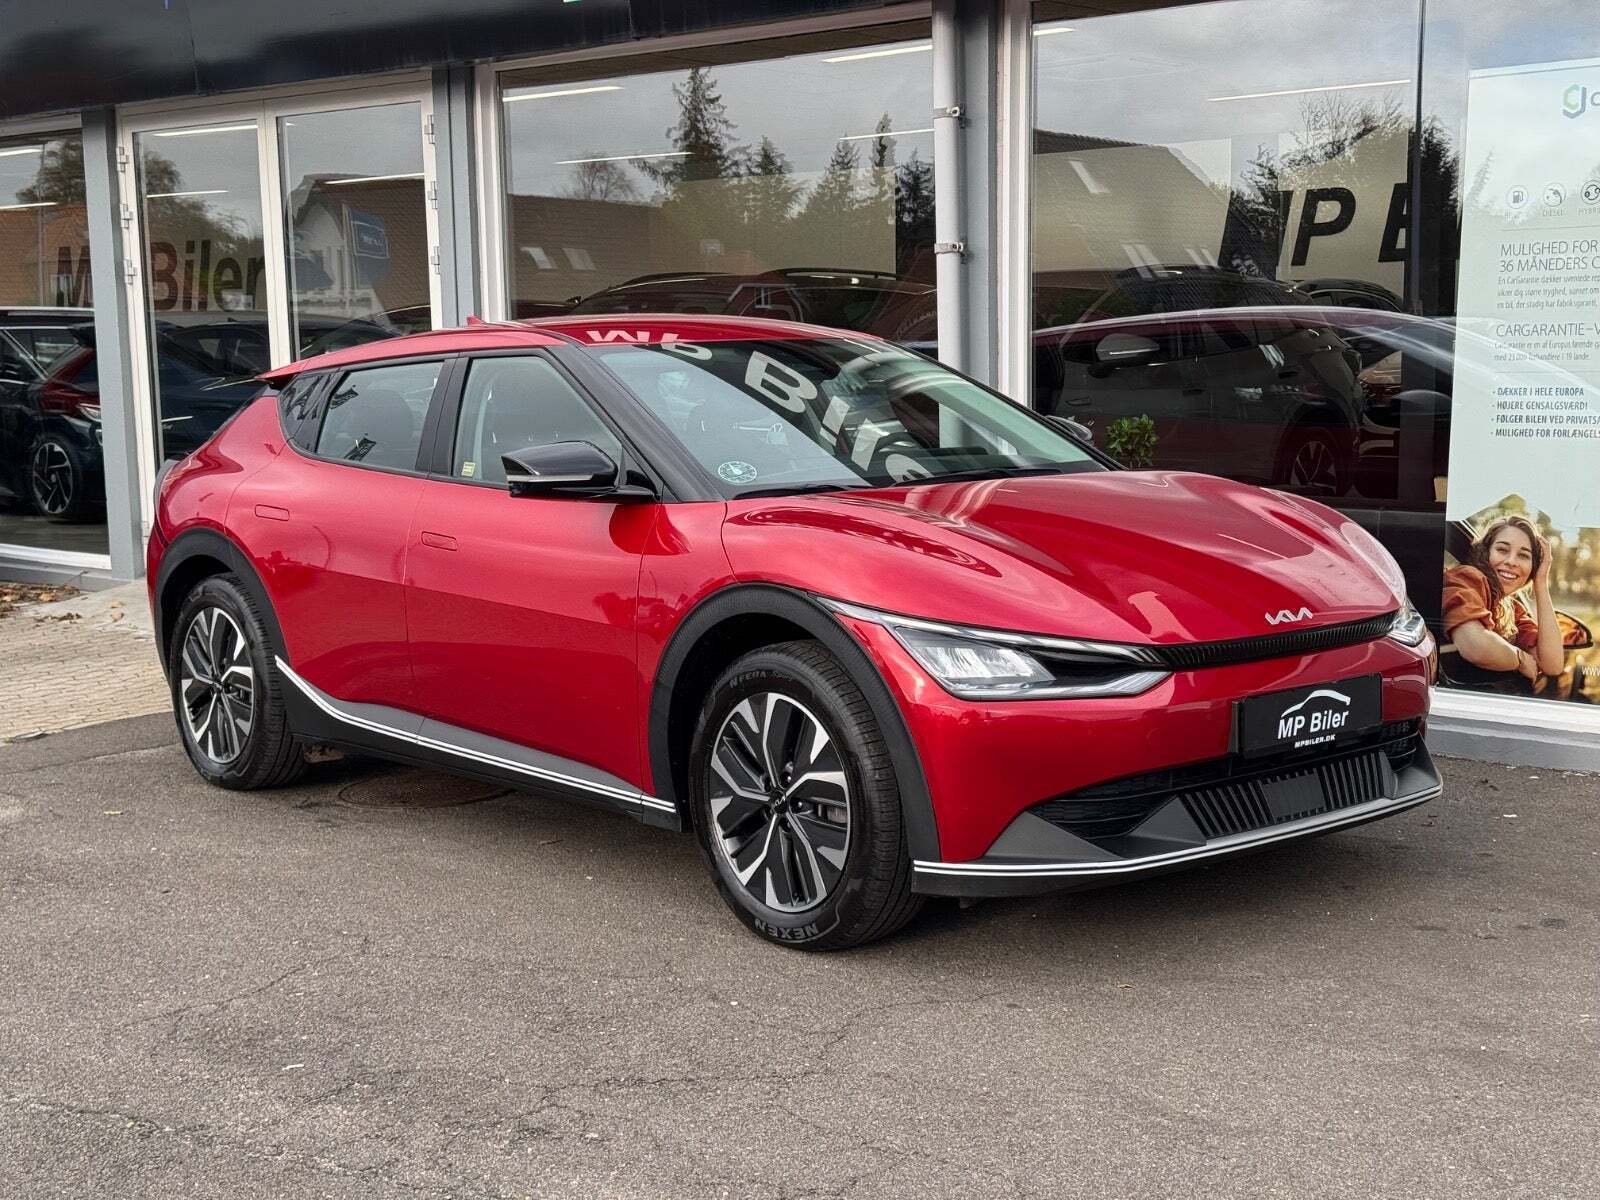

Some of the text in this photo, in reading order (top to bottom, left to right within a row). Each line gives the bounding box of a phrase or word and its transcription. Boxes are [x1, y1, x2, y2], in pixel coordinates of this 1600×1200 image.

[1500, 239, 1598, 257] MULIGHED FOR
[1499, 259, 1514, 273] 36
[1517, 256, 1588, 272] MÅNEDERS
[150, 239, 267, 312] Biler
[1495, 322, 1585, 337] CARGARANTIE
[1497, 387, 1528, 397] DÆKKER
[1534, 387, 1553, 396] HELE
[1555, 387, 1584, 396] EUROPA
[1497, 401, 1524, 410] HØJERE
[1496, 414, 1523, 423] FØLGER
[1525, 414, 1547, 423] BILEN
[1549, 415, 1564, 424] VED
[1495, 428, 1534, 437] MULIGHED
[1536, 429, 1551, 437] FOR
[1277, 708, 1350, 740] MP Biler
[1294, 733, 1336, 749] MPBILER.DK
[754, 917, 819, 941] NEXEN
